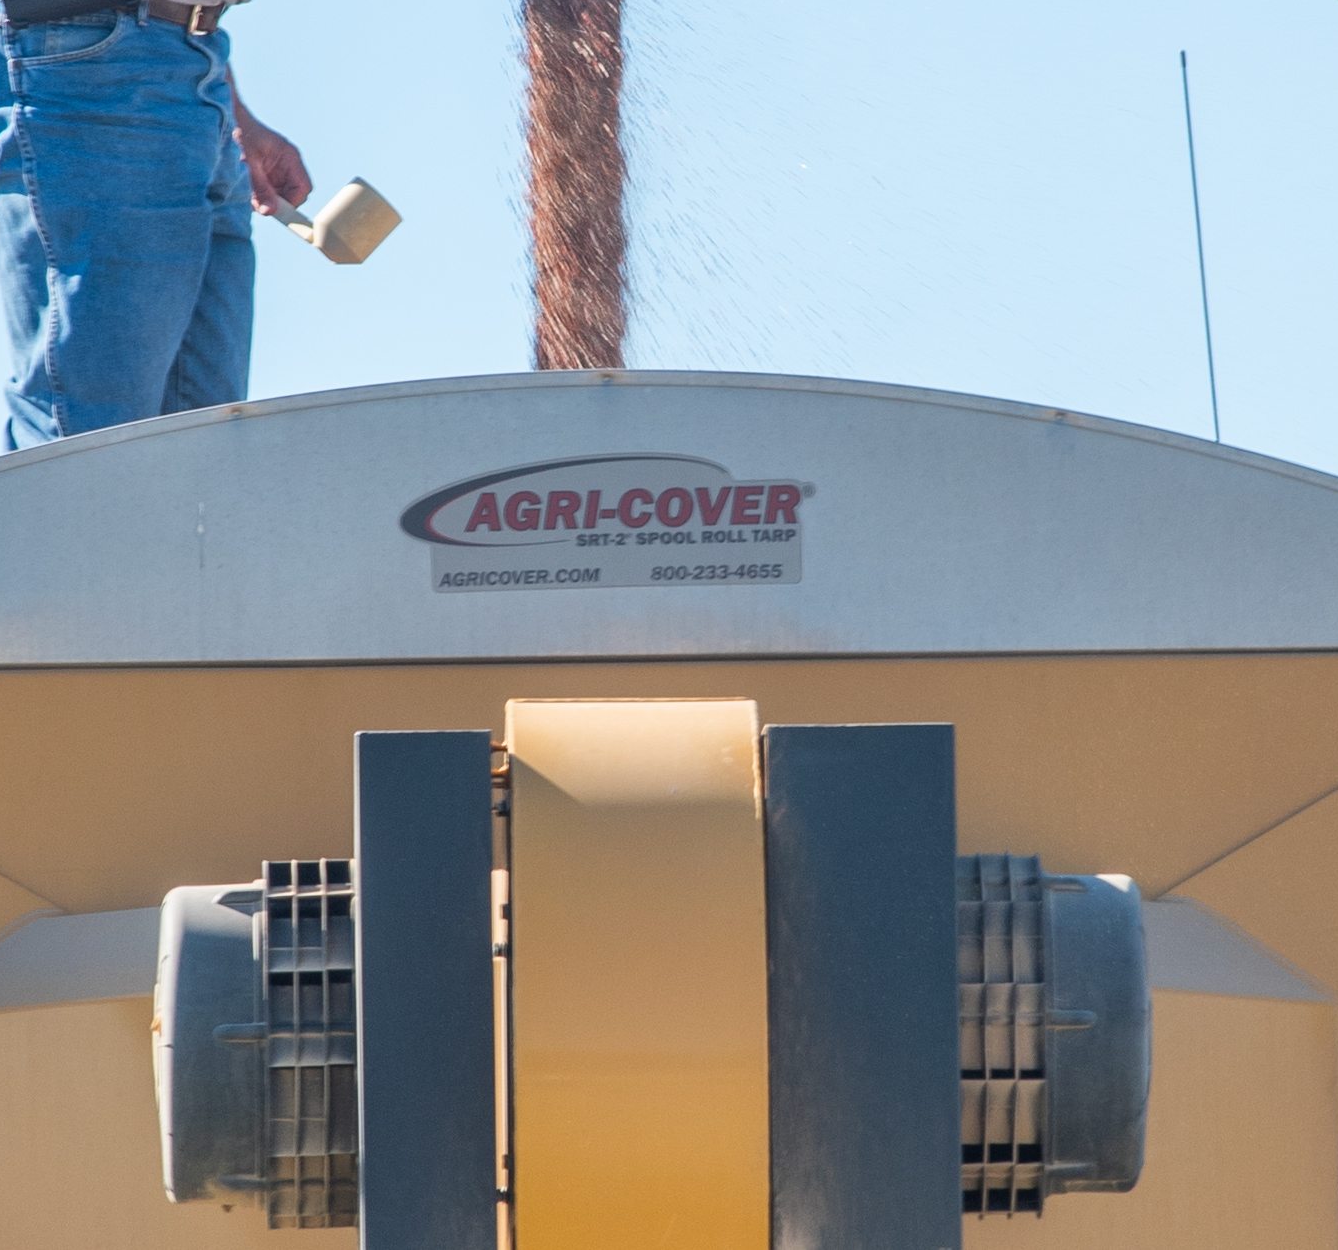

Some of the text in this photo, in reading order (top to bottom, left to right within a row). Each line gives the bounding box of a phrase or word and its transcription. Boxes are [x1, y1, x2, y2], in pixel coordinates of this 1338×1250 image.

[464, 484, 801, 533] AGRI-COVER
[635, 530, 697, 545] SPOOL
[701, 529, 748, 544] ROLL
[751, 528, 797, 543] TARP
[438, 564, 784, 588] AGRICOVER.COM 800-233-4655
